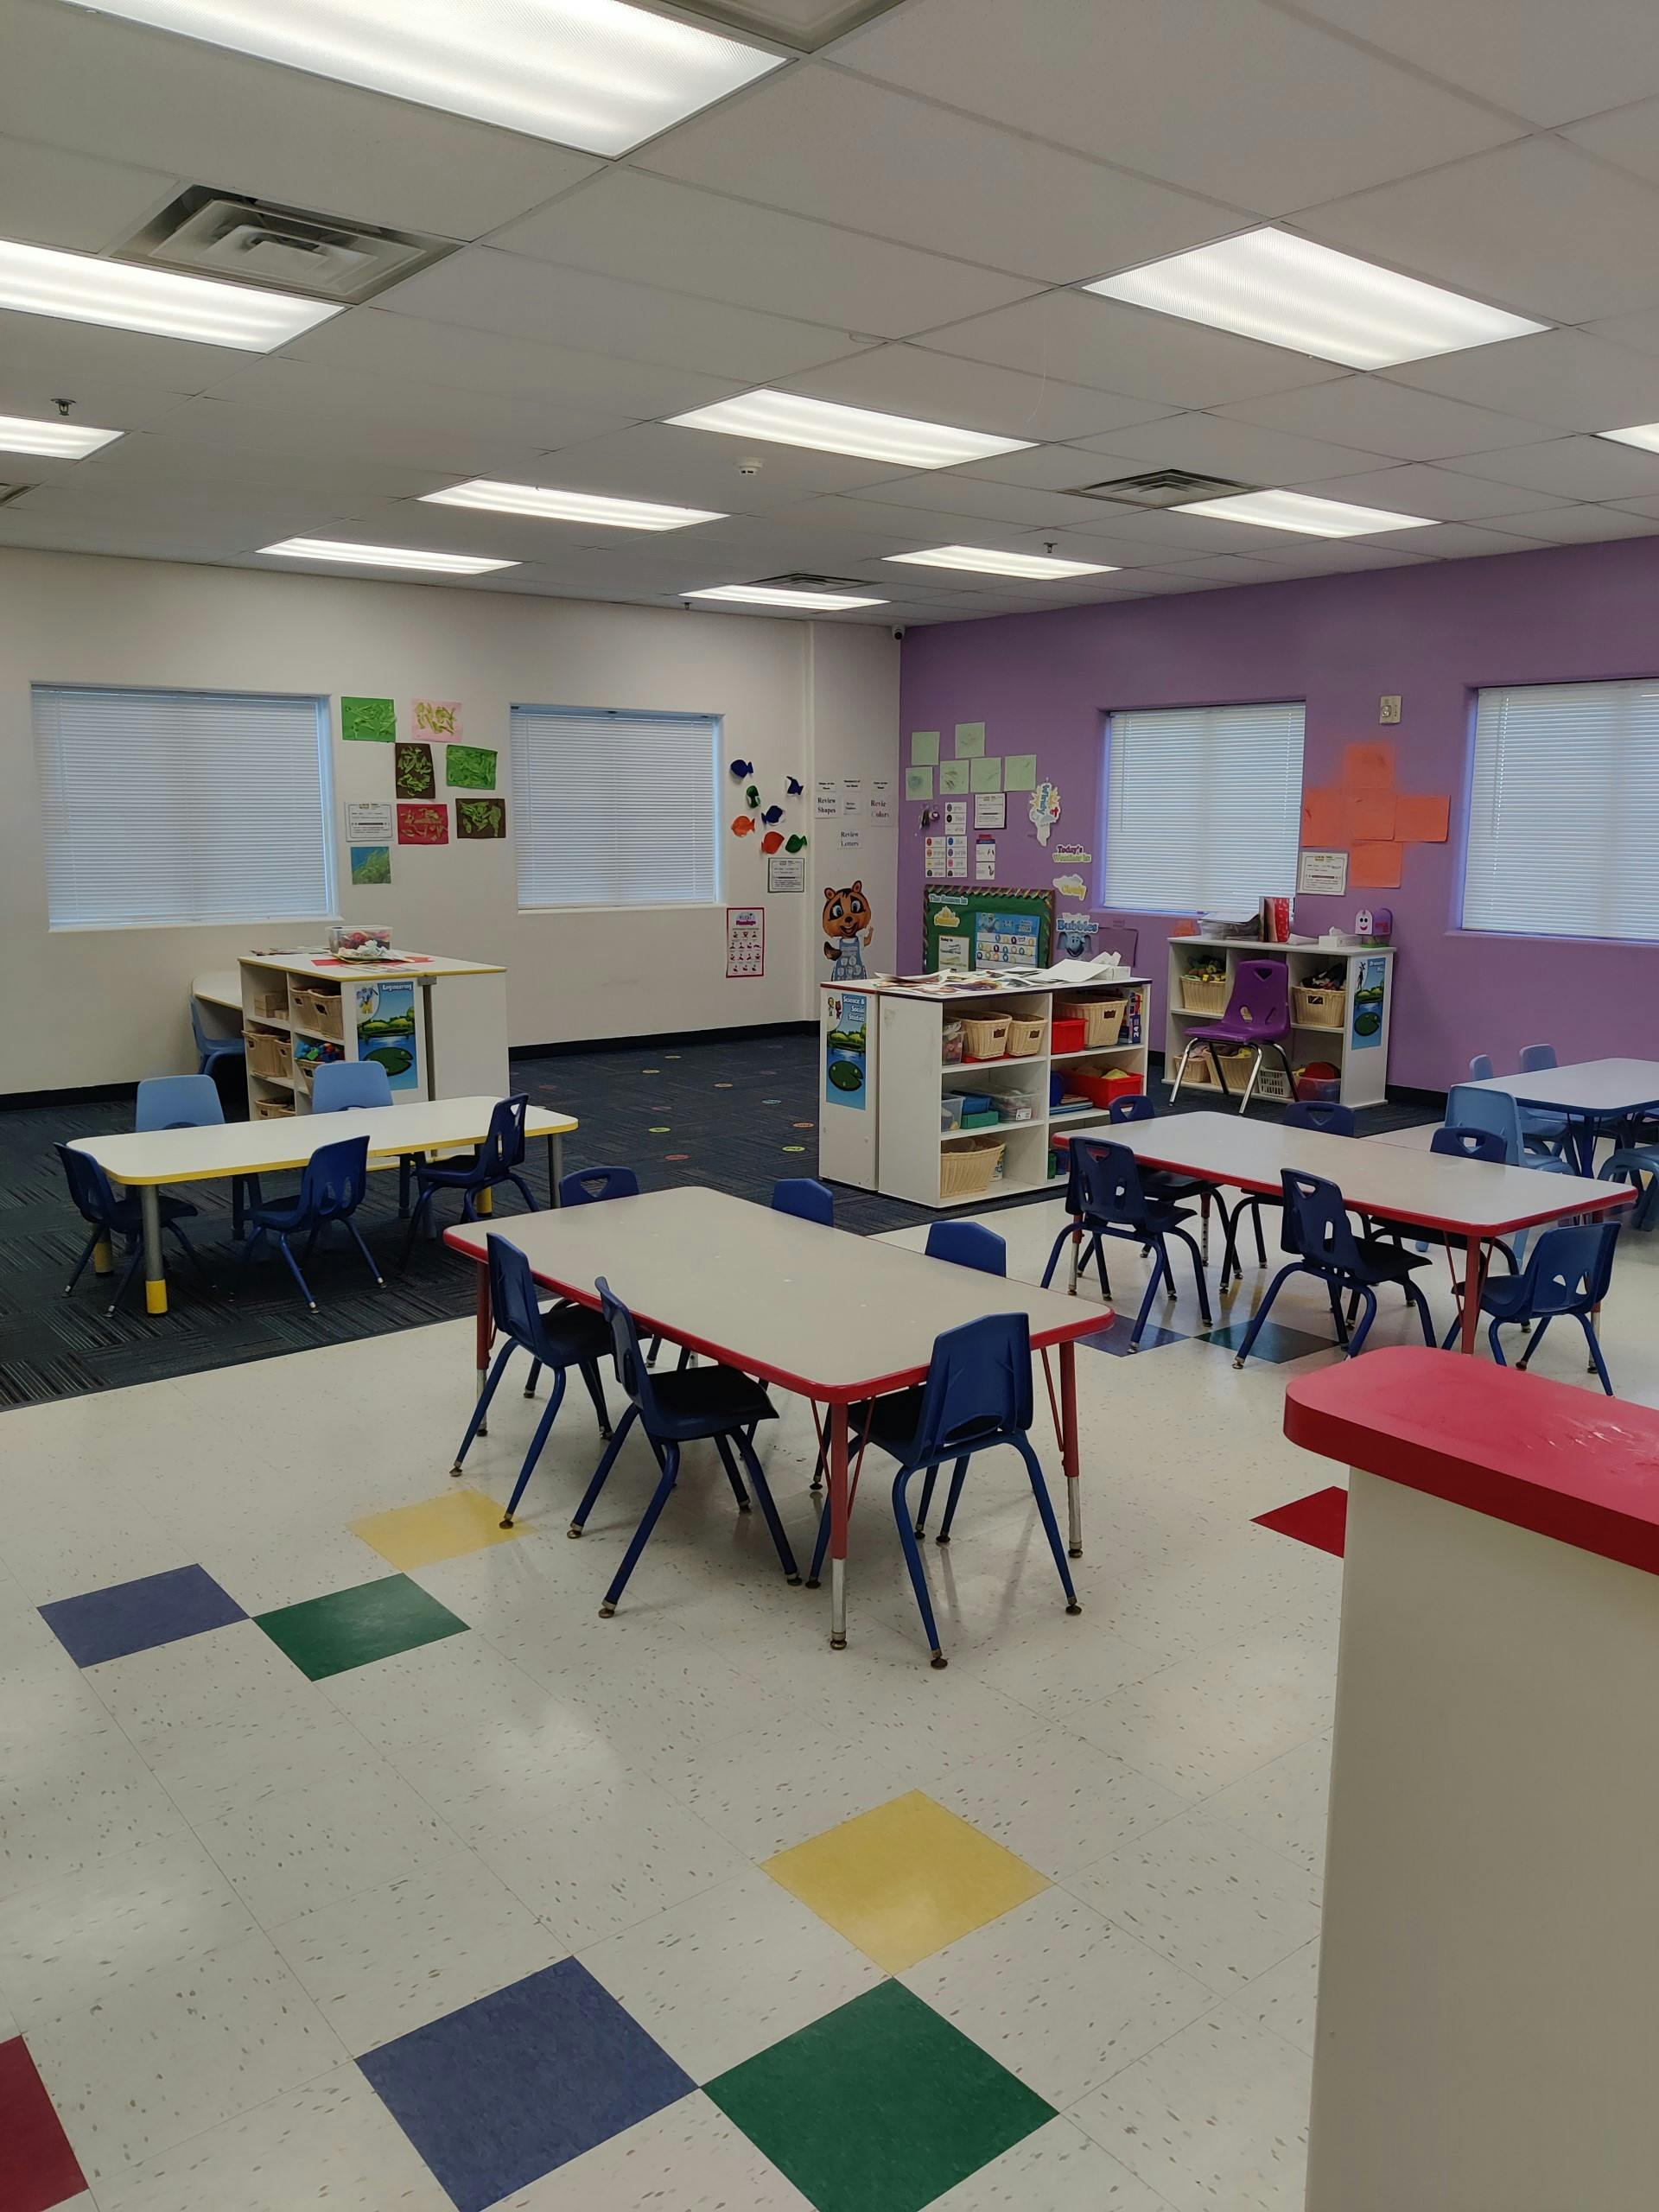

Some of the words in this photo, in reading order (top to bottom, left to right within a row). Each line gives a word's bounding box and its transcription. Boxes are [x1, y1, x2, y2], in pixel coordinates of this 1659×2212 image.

[1037, 785, 1050, 815] Windy
[817, 806, 836, 815] Shapes
[1057, 845, 1083, 855] Today's
[1057, 919, 1097, 932] Bubbles
[851, 1005, 864, 1014] Social
